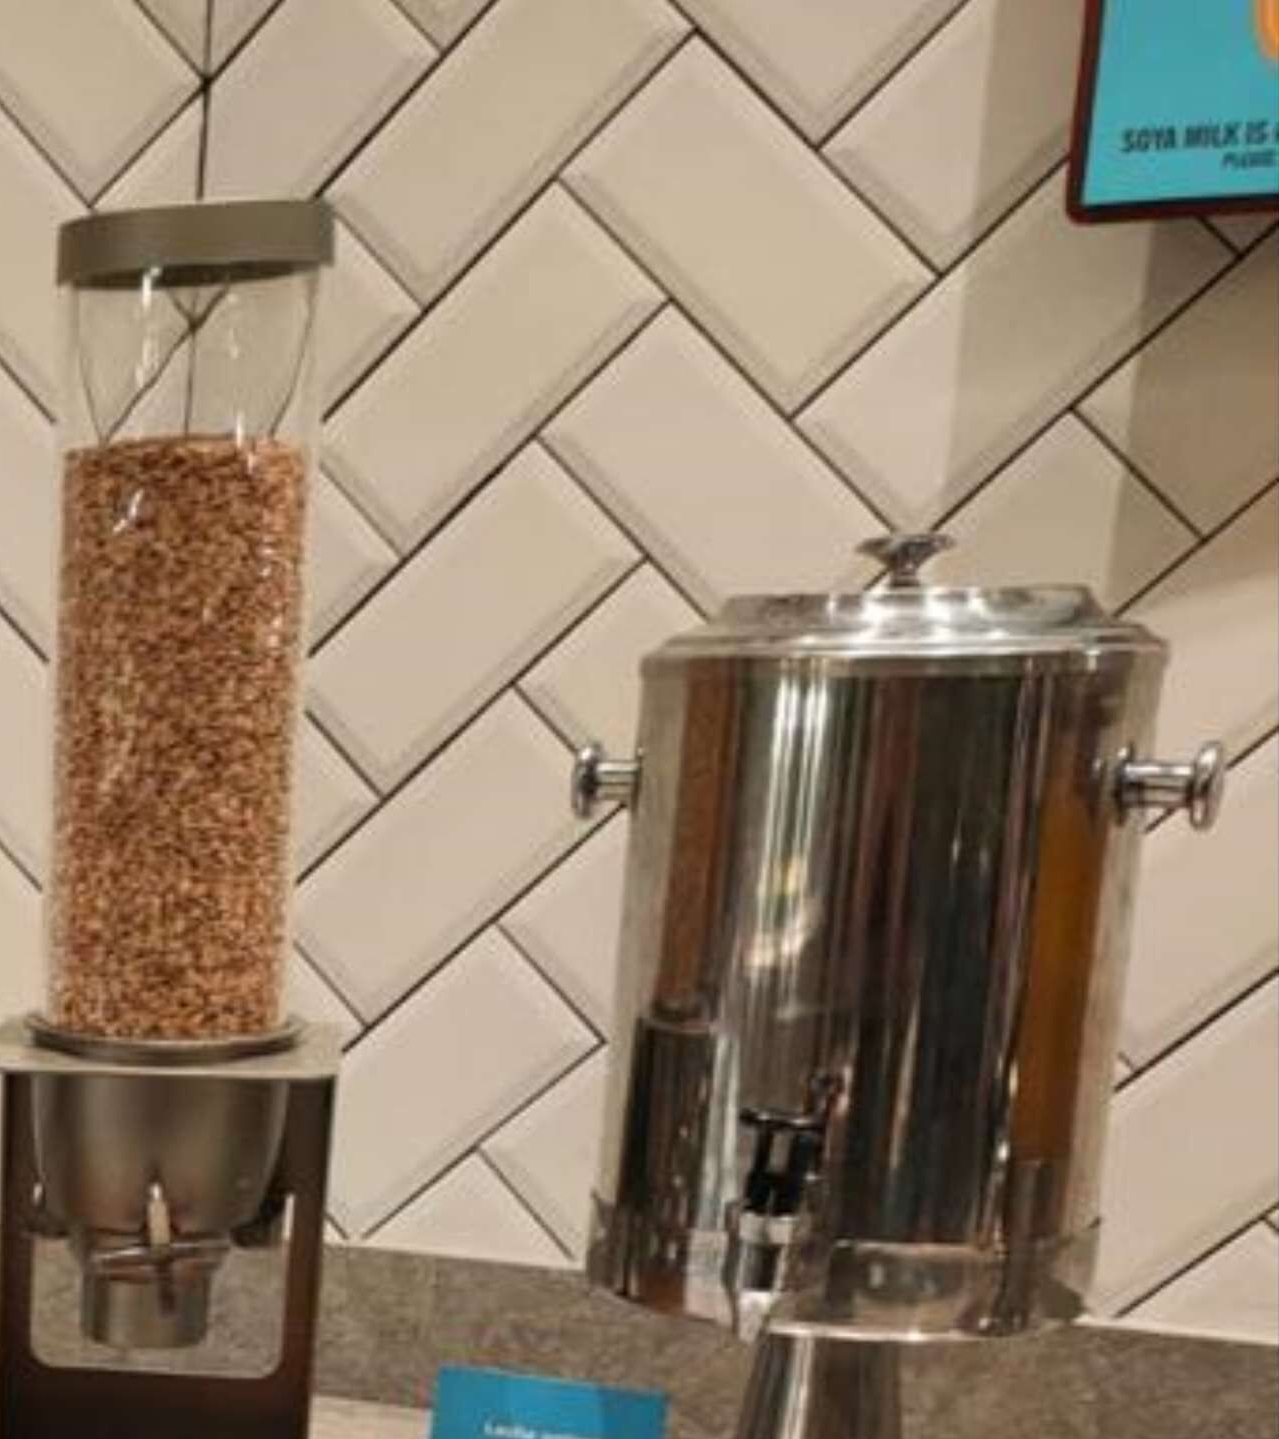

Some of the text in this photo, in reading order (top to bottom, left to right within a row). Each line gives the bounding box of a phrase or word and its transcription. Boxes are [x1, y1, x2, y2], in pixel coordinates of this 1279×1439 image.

[1122, 125, 1176, 152] SOYA
[1184, 121, 1240, 148] MILK
[1245, 119, 1268, 145] IS
